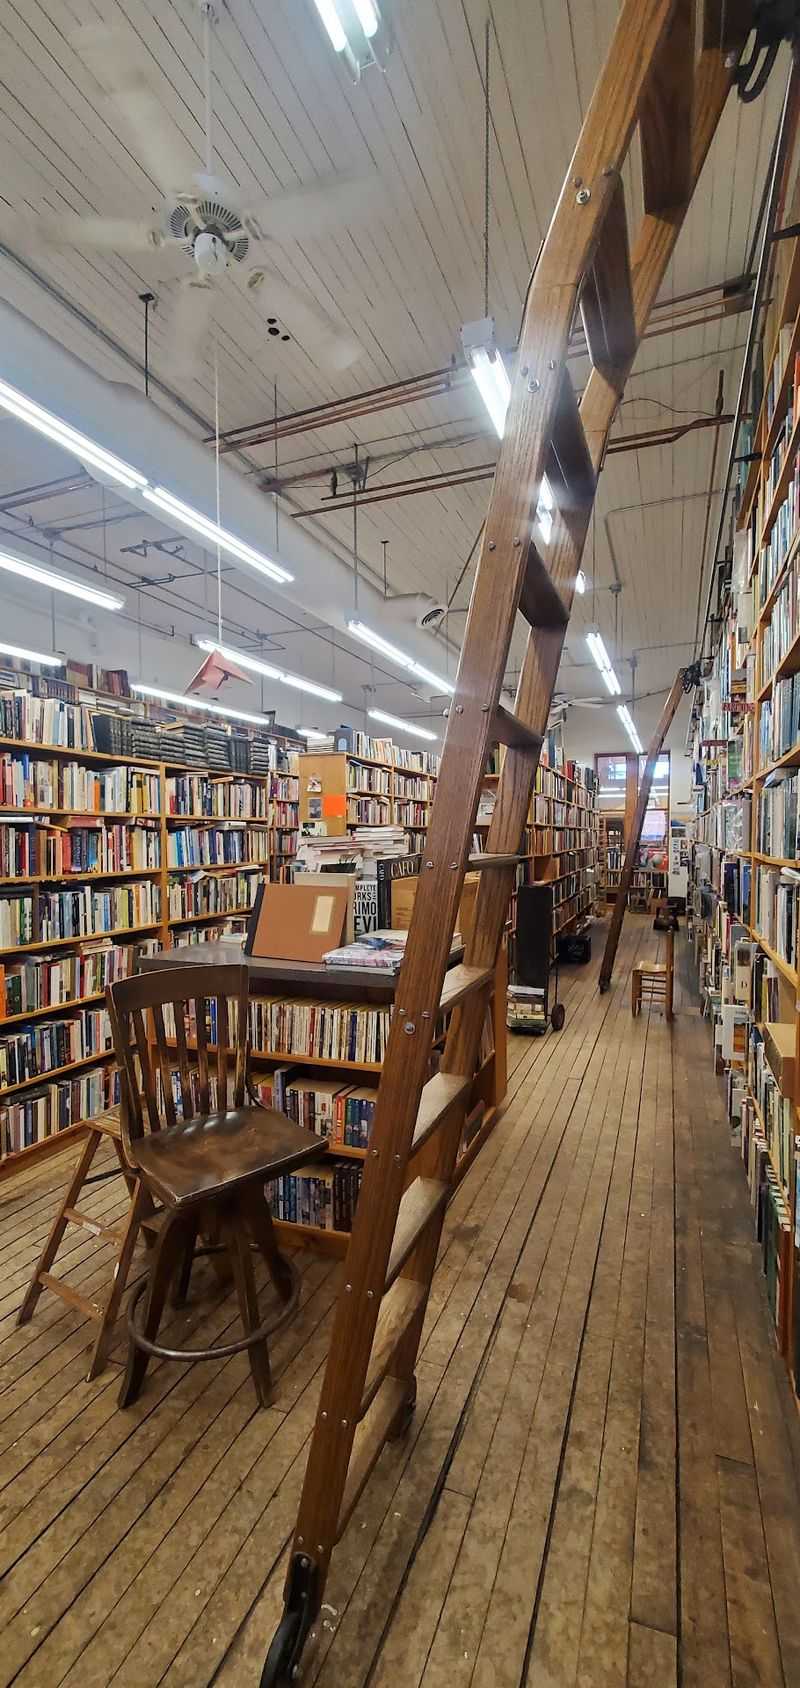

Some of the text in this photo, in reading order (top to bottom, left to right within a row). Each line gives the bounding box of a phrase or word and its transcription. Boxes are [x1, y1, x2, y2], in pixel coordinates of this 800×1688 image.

[355, 884, 377, 892] MPLETE
[353, 901, 377, 915] RIMO
[354, 915, 377, 933] EVI
